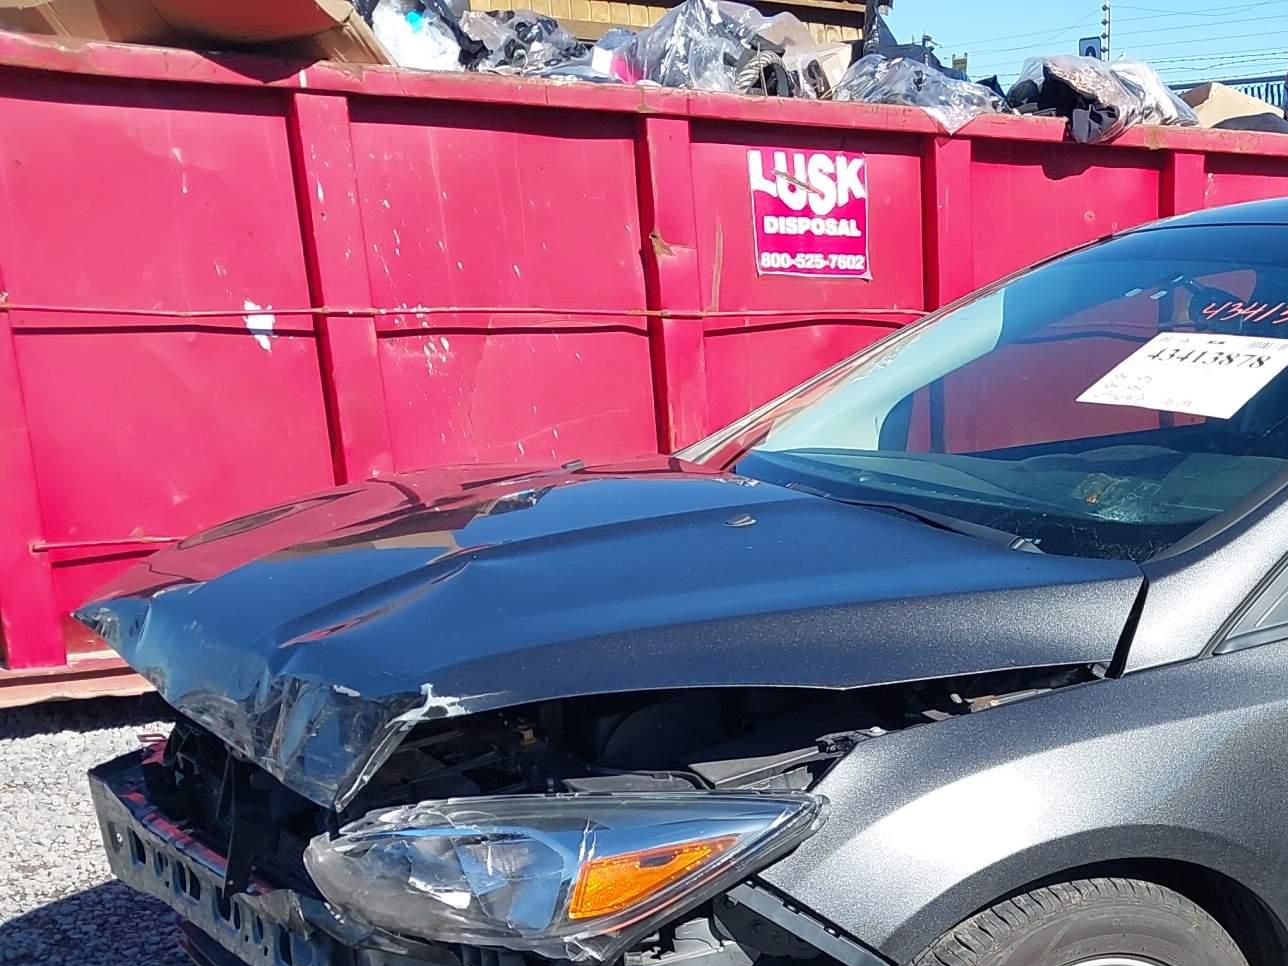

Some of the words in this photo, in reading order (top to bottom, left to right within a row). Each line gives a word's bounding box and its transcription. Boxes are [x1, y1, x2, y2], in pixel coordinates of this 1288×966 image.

[749, 151, 866, 215] LUSK
[763, 216, 862, 237] DISPOSAL
[760, 252, 866, 270] 800-525-7602
[1147, 348, 1271, 368] 43413878
